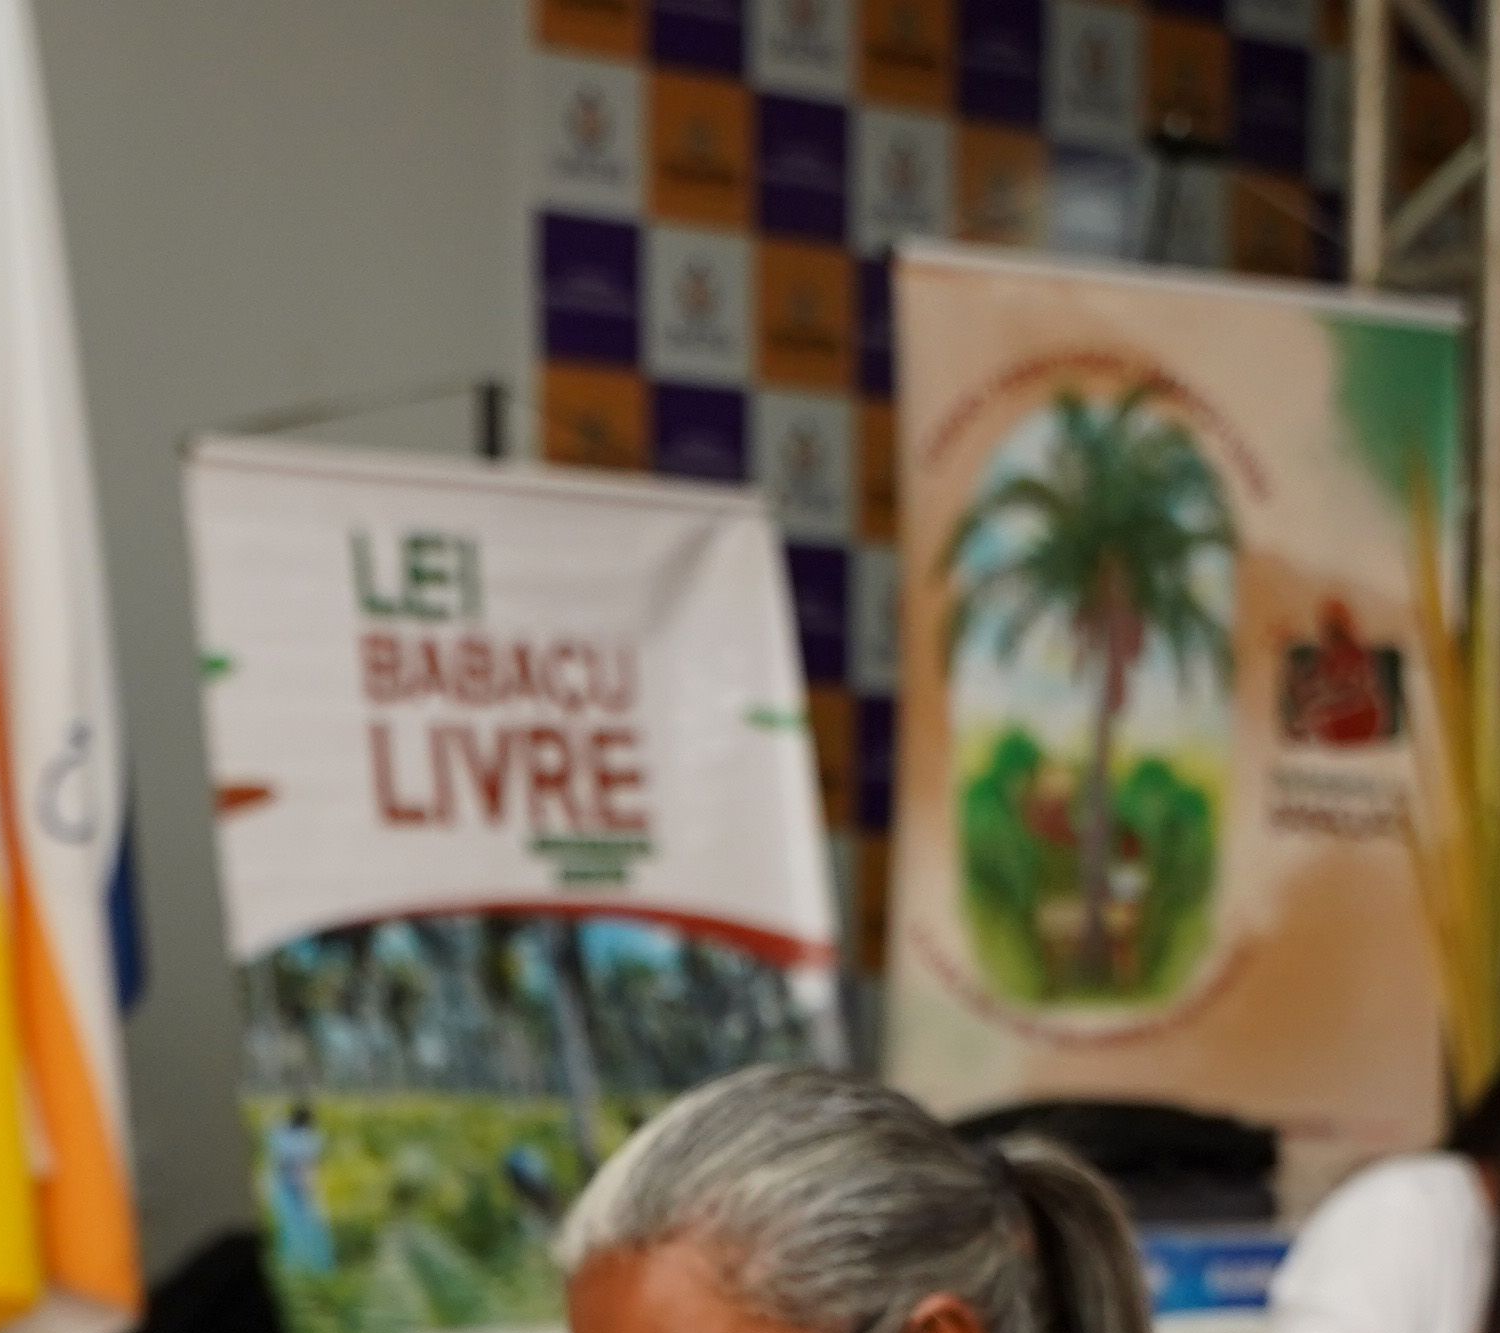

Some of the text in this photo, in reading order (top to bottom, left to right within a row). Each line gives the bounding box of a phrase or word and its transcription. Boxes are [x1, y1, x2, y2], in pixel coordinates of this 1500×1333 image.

[348, 530, 482, 620] LEI
[358, 632, 638, 712] BABAÇU
[366, 722, 650, 830] LIVRE
